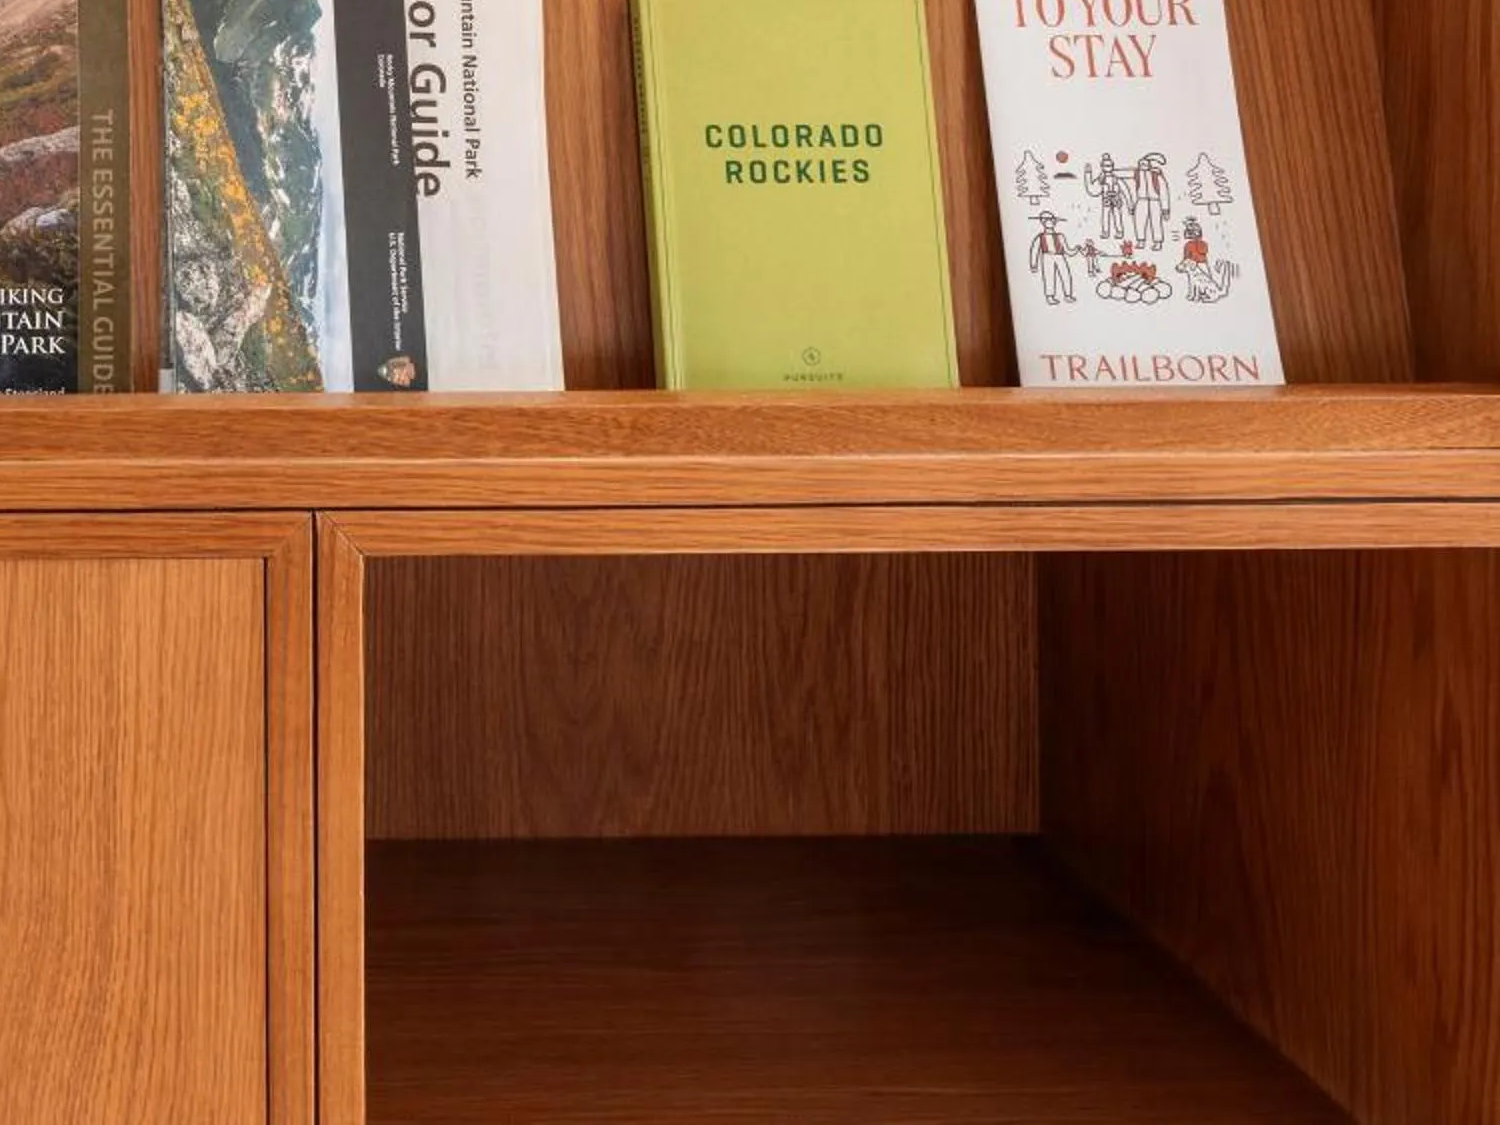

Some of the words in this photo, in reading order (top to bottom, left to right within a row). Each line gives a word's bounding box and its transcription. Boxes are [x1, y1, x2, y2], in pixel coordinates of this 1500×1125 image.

[1048, 33, 1158, 80] STAY
[461, 55, 480, 132] National
[92, 108, 114, 161] THE
[409, 63, 452, 197] Guide
[704, 123, 885, 149] COLORADO
[464, 138, 483, 179] Park
[725, 159, 872, 185] ROCKIES
[92, 169, 115, 311] ESSENTIAL
[0, 335, 67, 355] PARK
[1040, 353, 1261, 382] TRAILBORN
